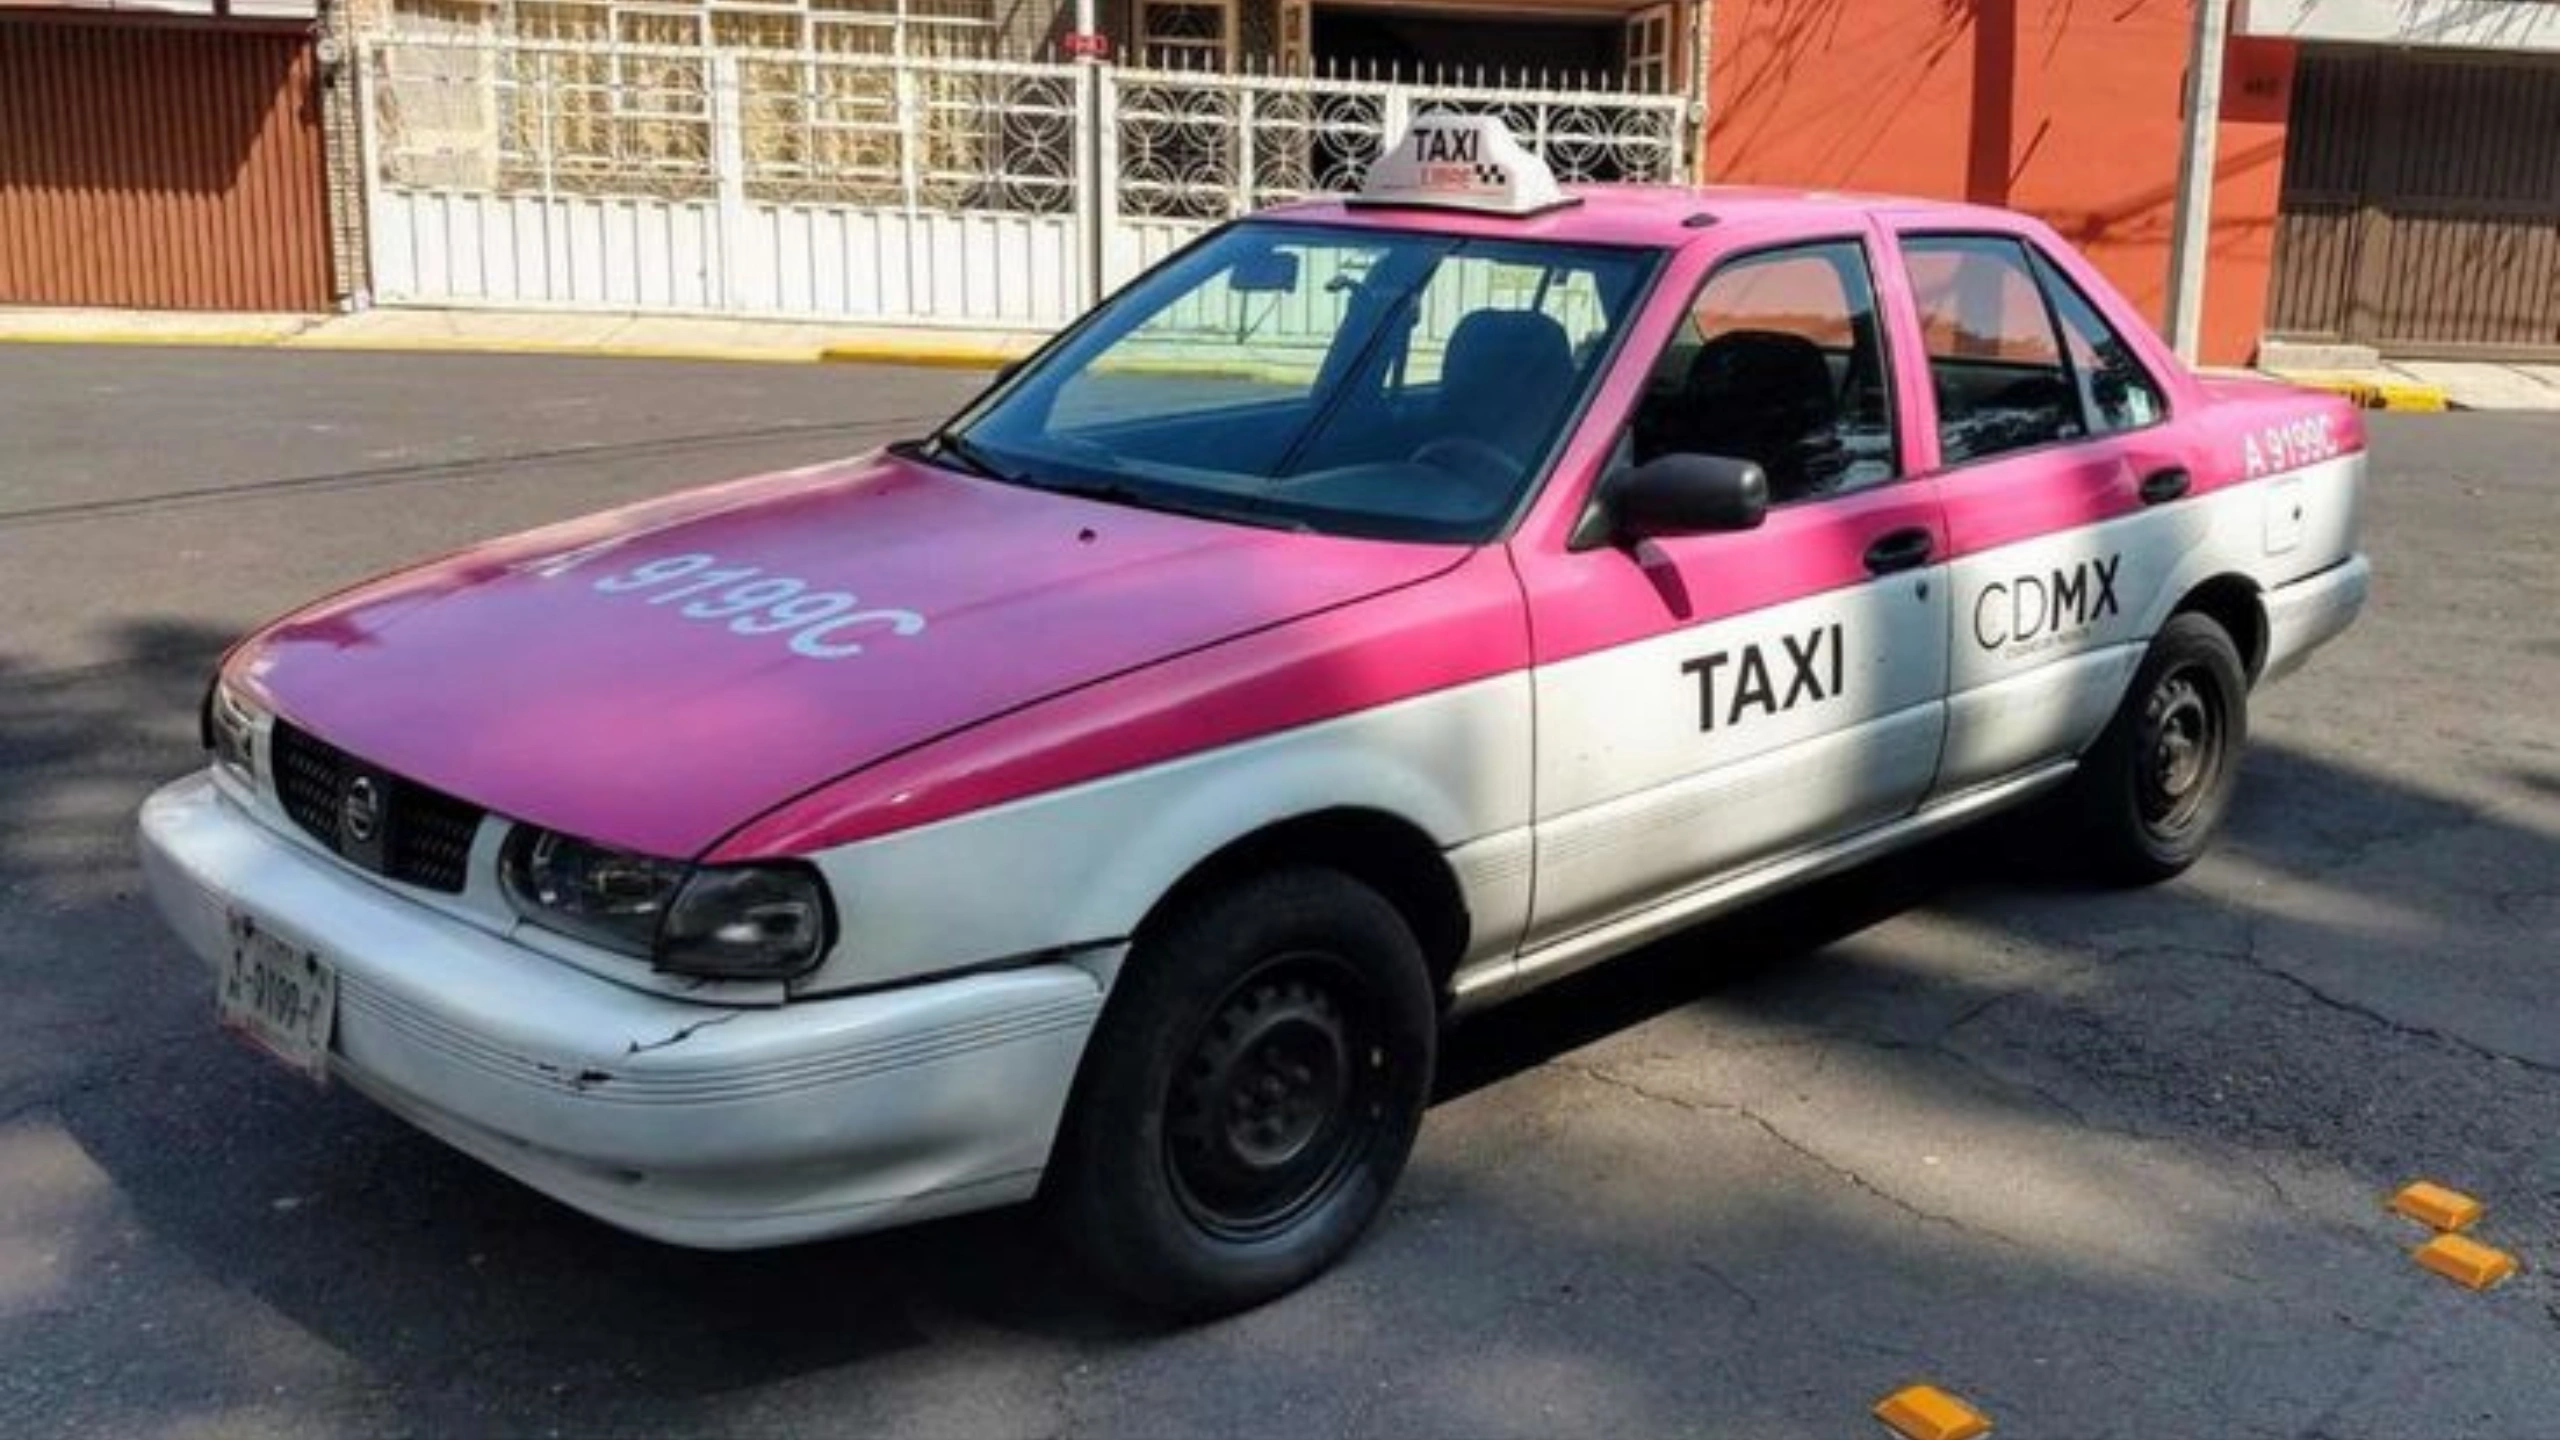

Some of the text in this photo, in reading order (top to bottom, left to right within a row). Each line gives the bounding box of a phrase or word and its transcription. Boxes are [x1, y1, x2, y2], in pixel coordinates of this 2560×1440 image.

[1413, 127, 1480, 162] TAXI
[2244, 413, 2338, 479] A 9199C
[593, 553, 925, 658] 9199C
[1973, 552, 2121, 650] CDMX
[1681, 622, 1843, 733] TAXI
